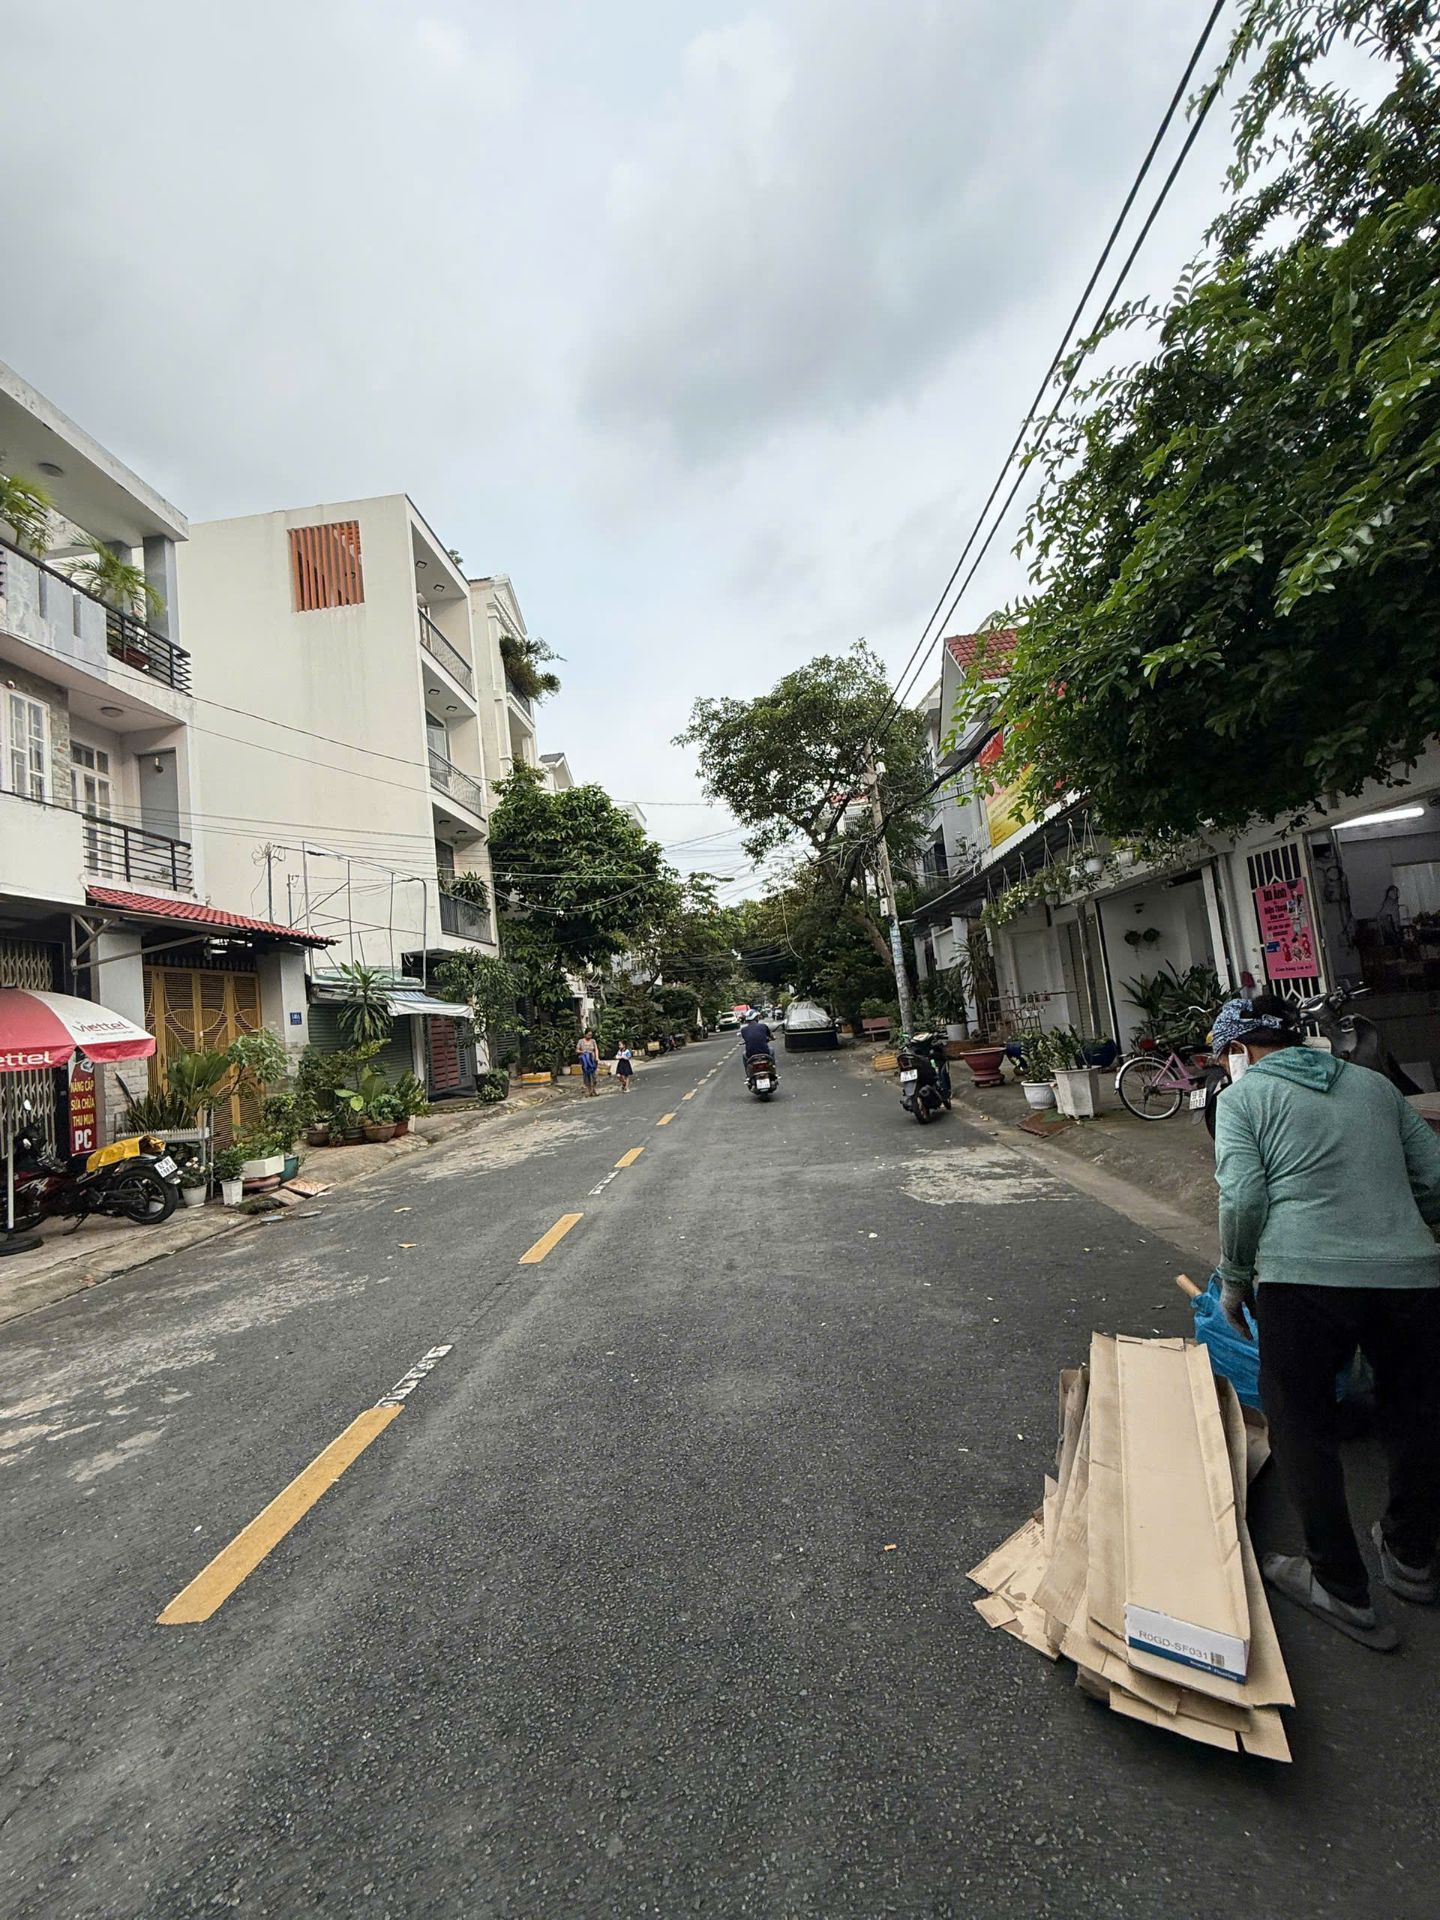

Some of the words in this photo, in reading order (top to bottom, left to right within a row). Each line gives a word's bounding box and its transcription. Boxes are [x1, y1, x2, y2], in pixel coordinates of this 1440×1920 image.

[72, 1115, 83, 1127] THU
[83, 1114, 94, 1125] MUA
[74, 1129, 92, 1151] PC
